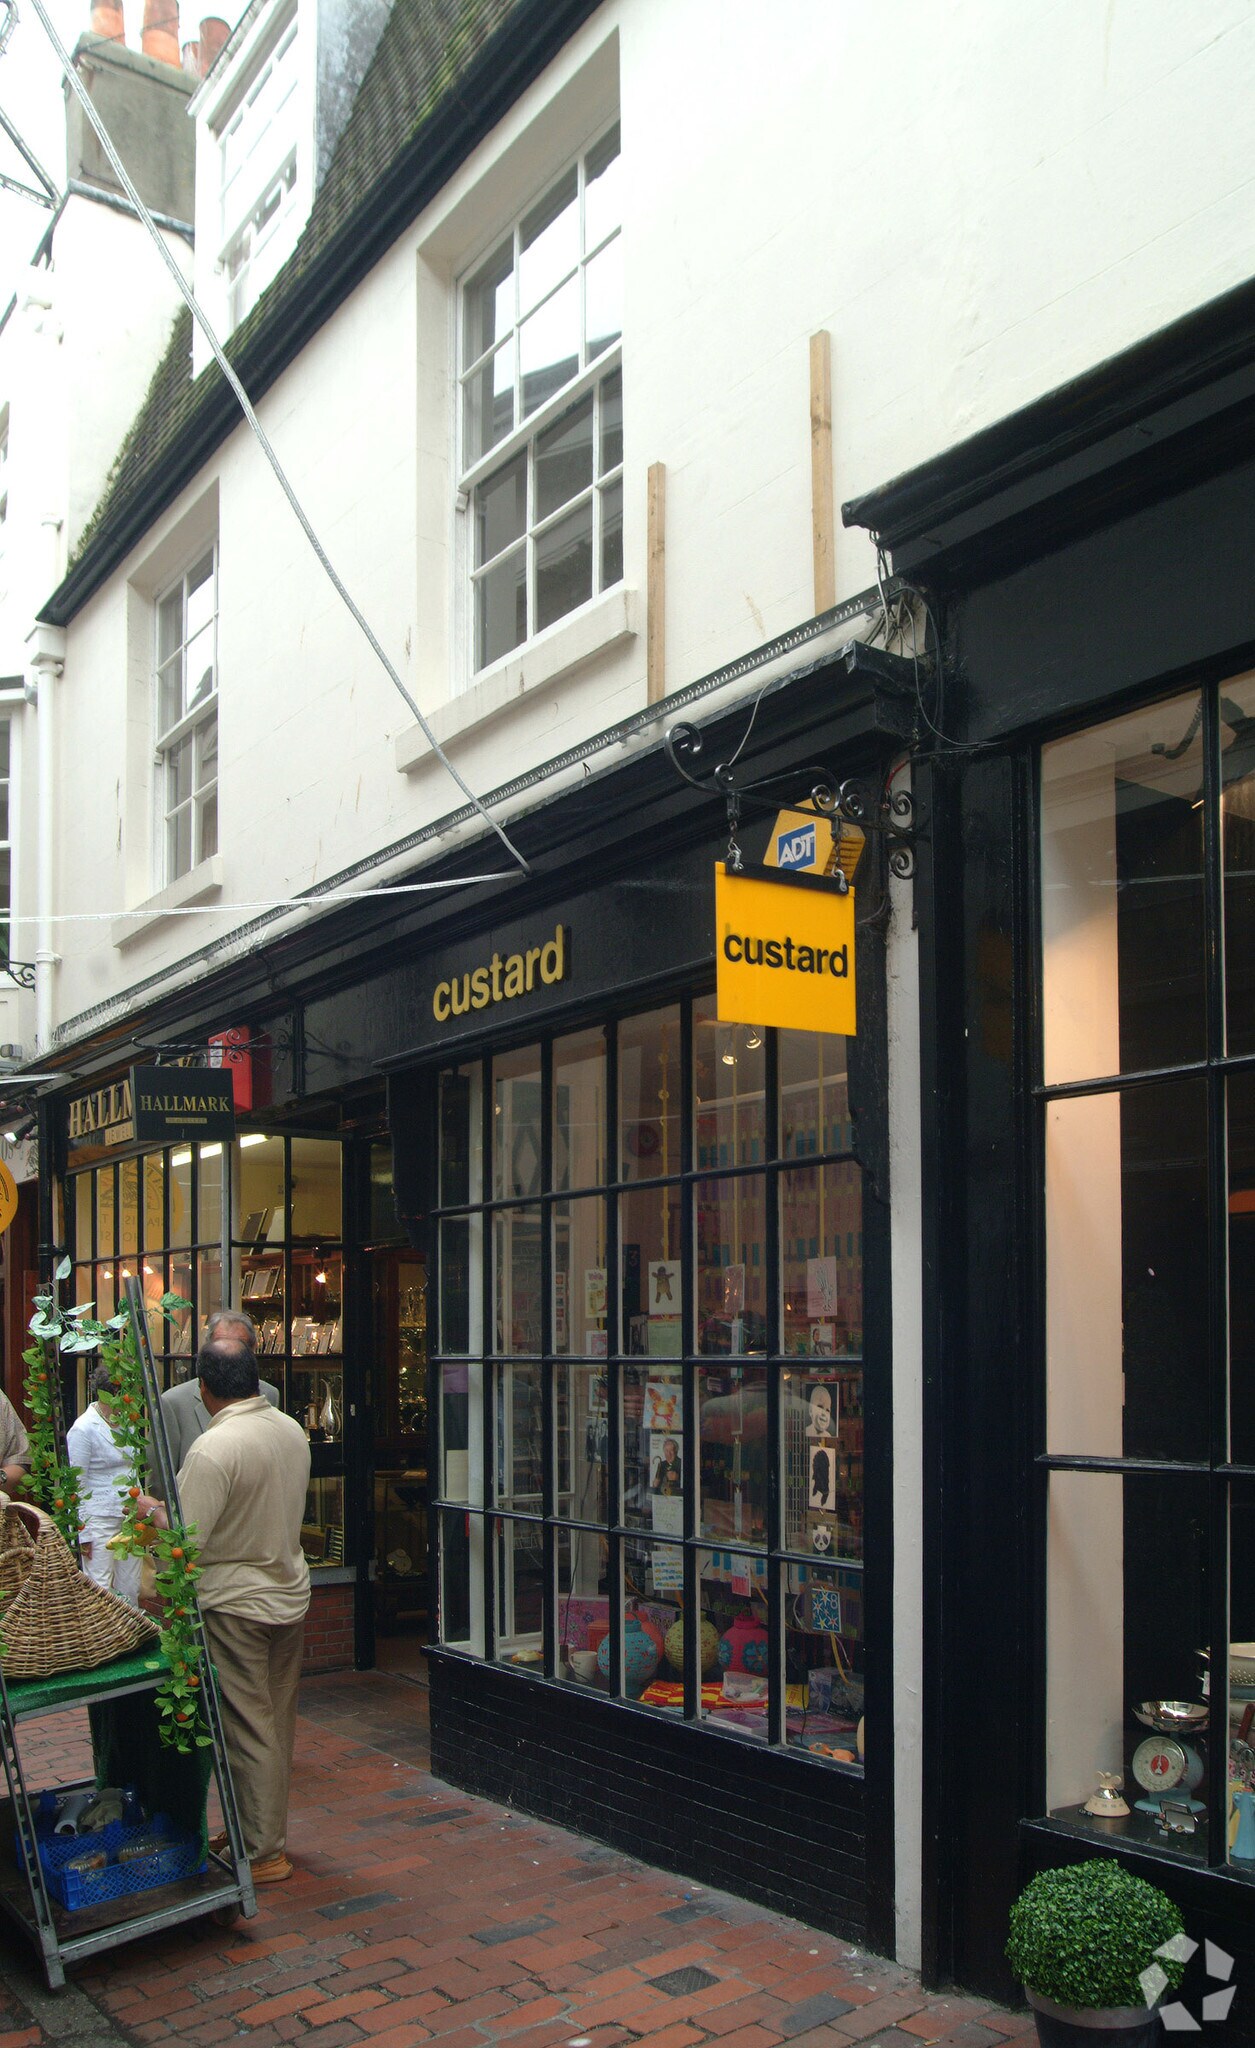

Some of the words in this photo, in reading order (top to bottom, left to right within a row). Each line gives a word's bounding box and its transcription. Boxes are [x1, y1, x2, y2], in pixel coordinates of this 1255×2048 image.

[779, 831, 815, 868] ADT
[432, 924, 564, 1022] custard
[723, 934, 848, 978] custard
[69, 1079, 133, 1139] HALLM
[140, 1095, 230, 1112] HALLMARK
[107, 1124, 133, 1143] JEWELL
[830, 1594, 838, 1610] 8
